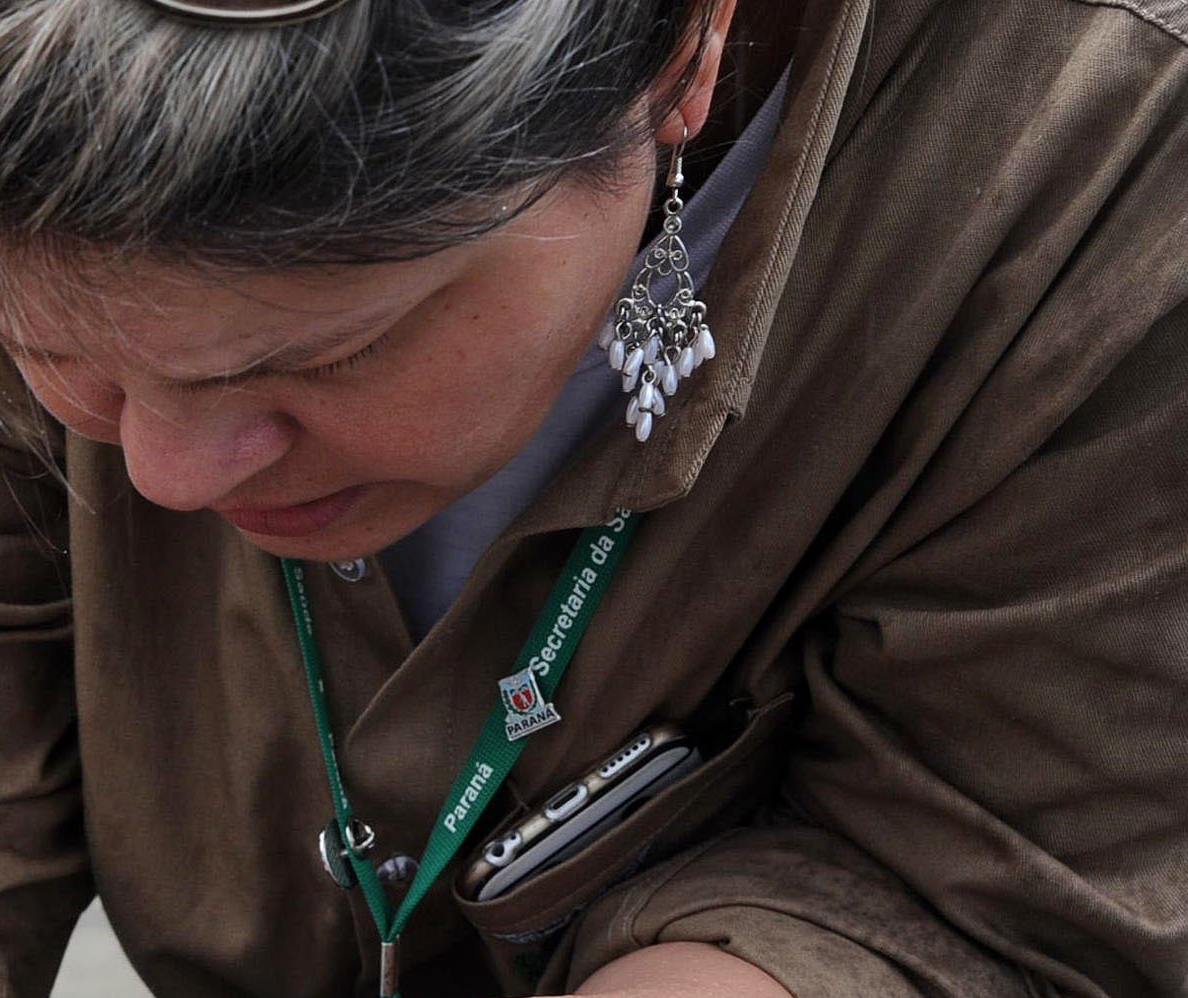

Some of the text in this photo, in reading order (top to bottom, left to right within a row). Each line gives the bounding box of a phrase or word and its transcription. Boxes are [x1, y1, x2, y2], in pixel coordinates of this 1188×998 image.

[529, 566, 597, 676] Secretaria
[590, 536, 615, 565] da
[443, 761, 494, 834] Paraná
